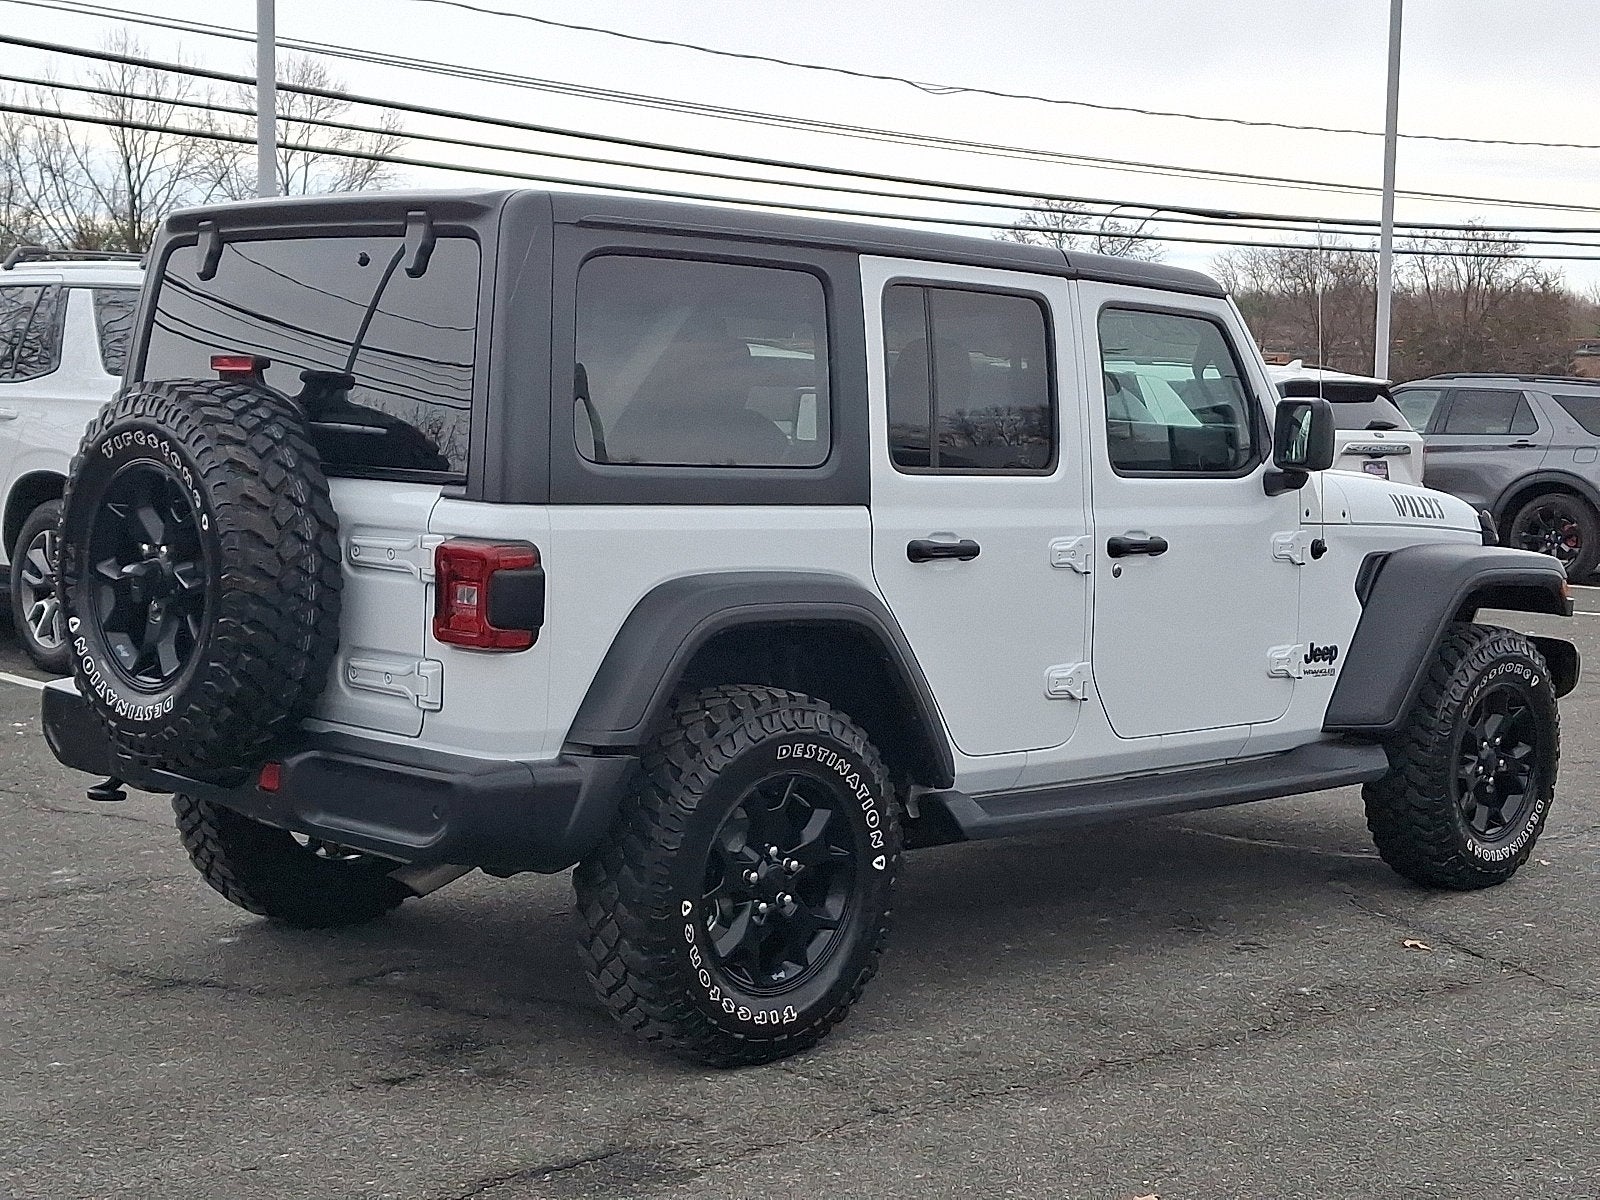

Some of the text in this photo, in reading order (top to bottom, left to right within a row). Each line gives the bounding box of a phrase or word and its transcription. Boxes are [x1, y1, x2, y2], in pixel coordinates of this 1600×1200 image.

[1388, 493, 1445, 519] WILLYS
[74, 637, 174, 721] DESTINATION
[1303, 642, 1339, 665] Jeep
[777, 743, 884, 849] DESTINATION
[1474, 799, 1545, 862] DESTINATION
